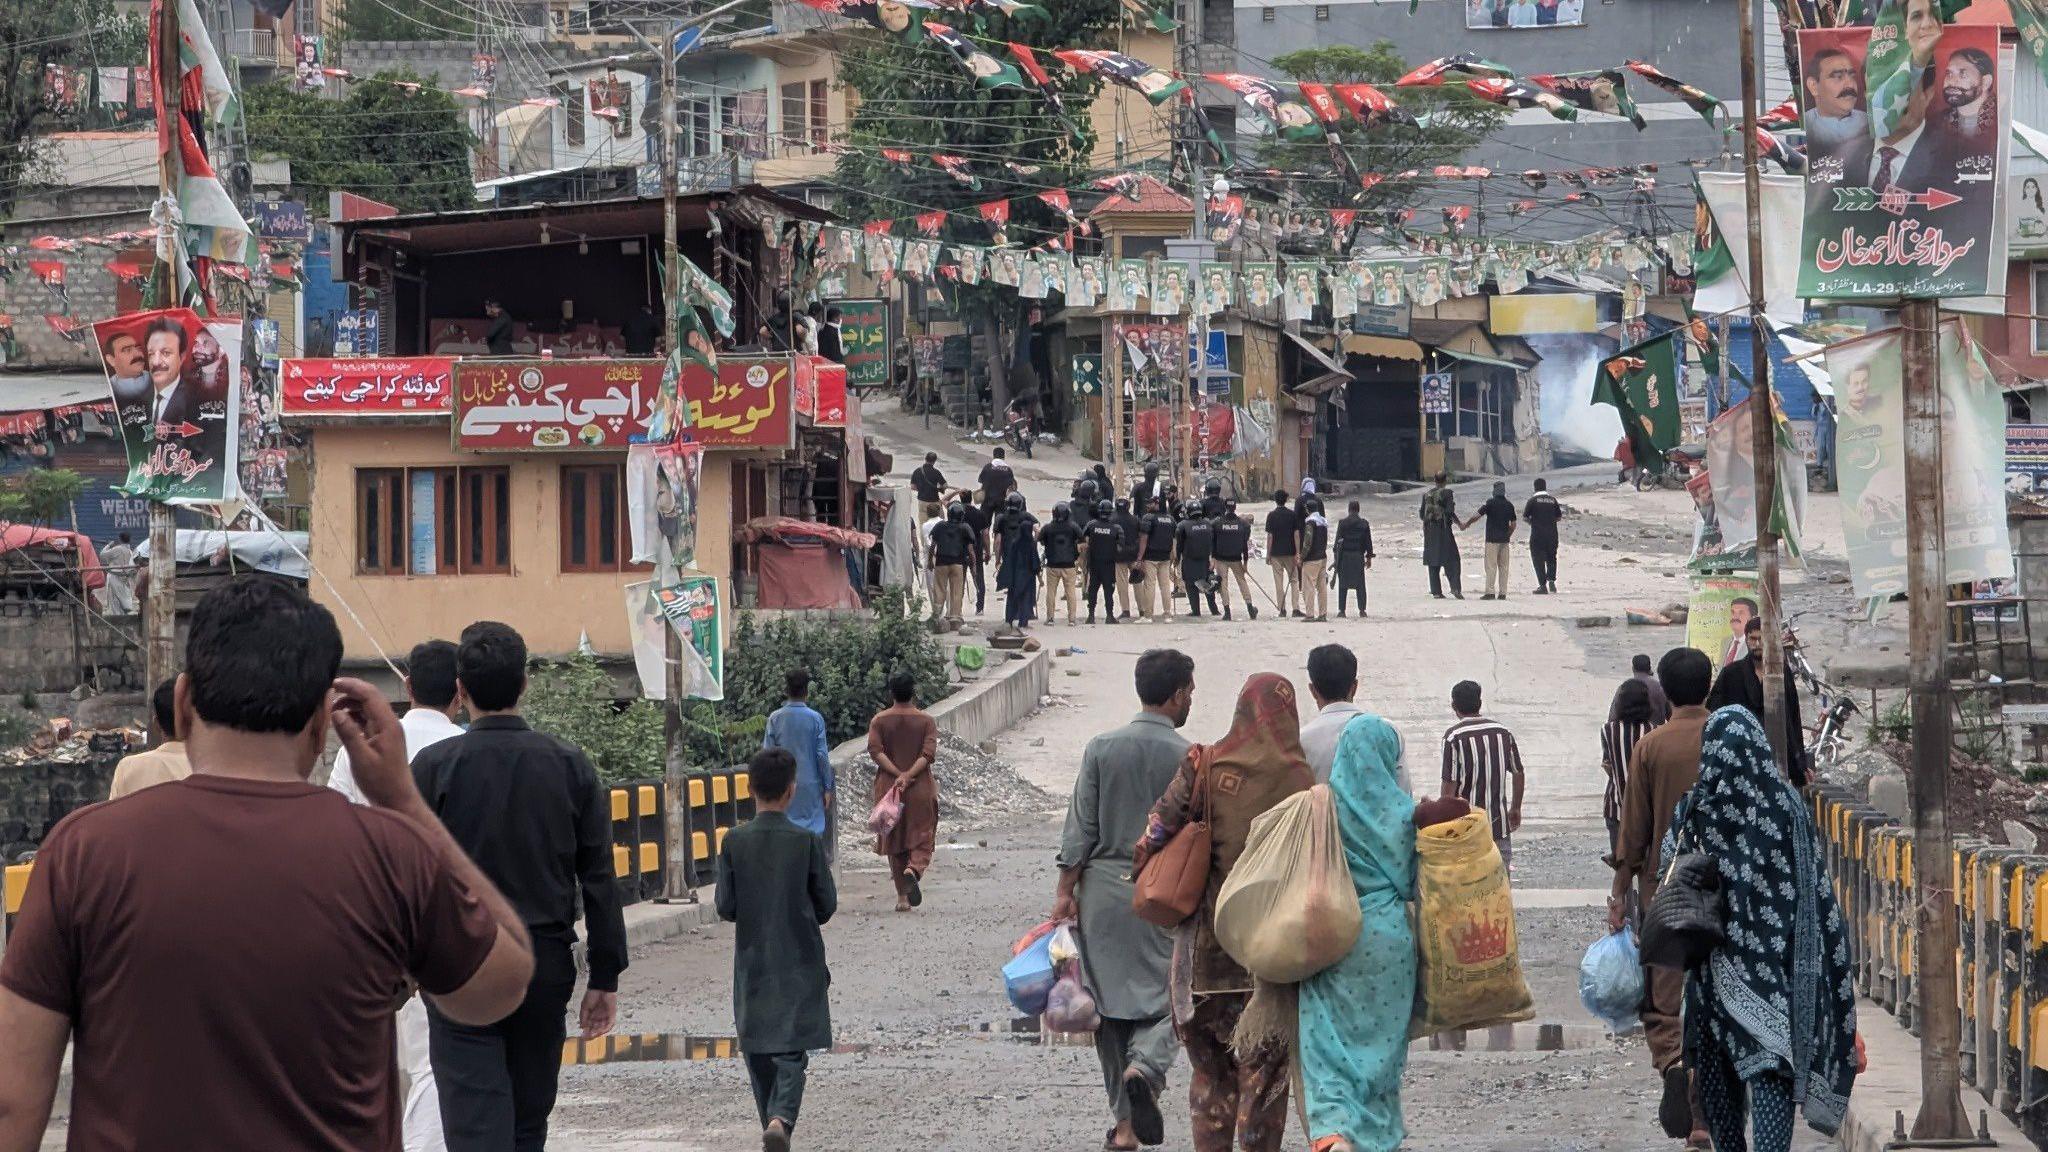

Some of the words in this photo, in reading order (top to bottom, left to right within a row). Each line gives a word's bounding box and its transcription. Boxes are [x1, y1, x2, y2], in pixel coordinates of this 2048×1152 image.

[1816, 227, 1864, 273] خان
[1852, 283, 1894, 293] LA-29
[303, 374, 343, 403] کیفے
[341, 375, 402, 403] کراچی
[403, 373, 447, 402] کوئٹہ
[461, 383, 569, 436] کیفے
[565, 381, 663, 434] راچی
[114, 515, 149, 529] PAINT
[1094, 527, 1111, 535] POLICE
